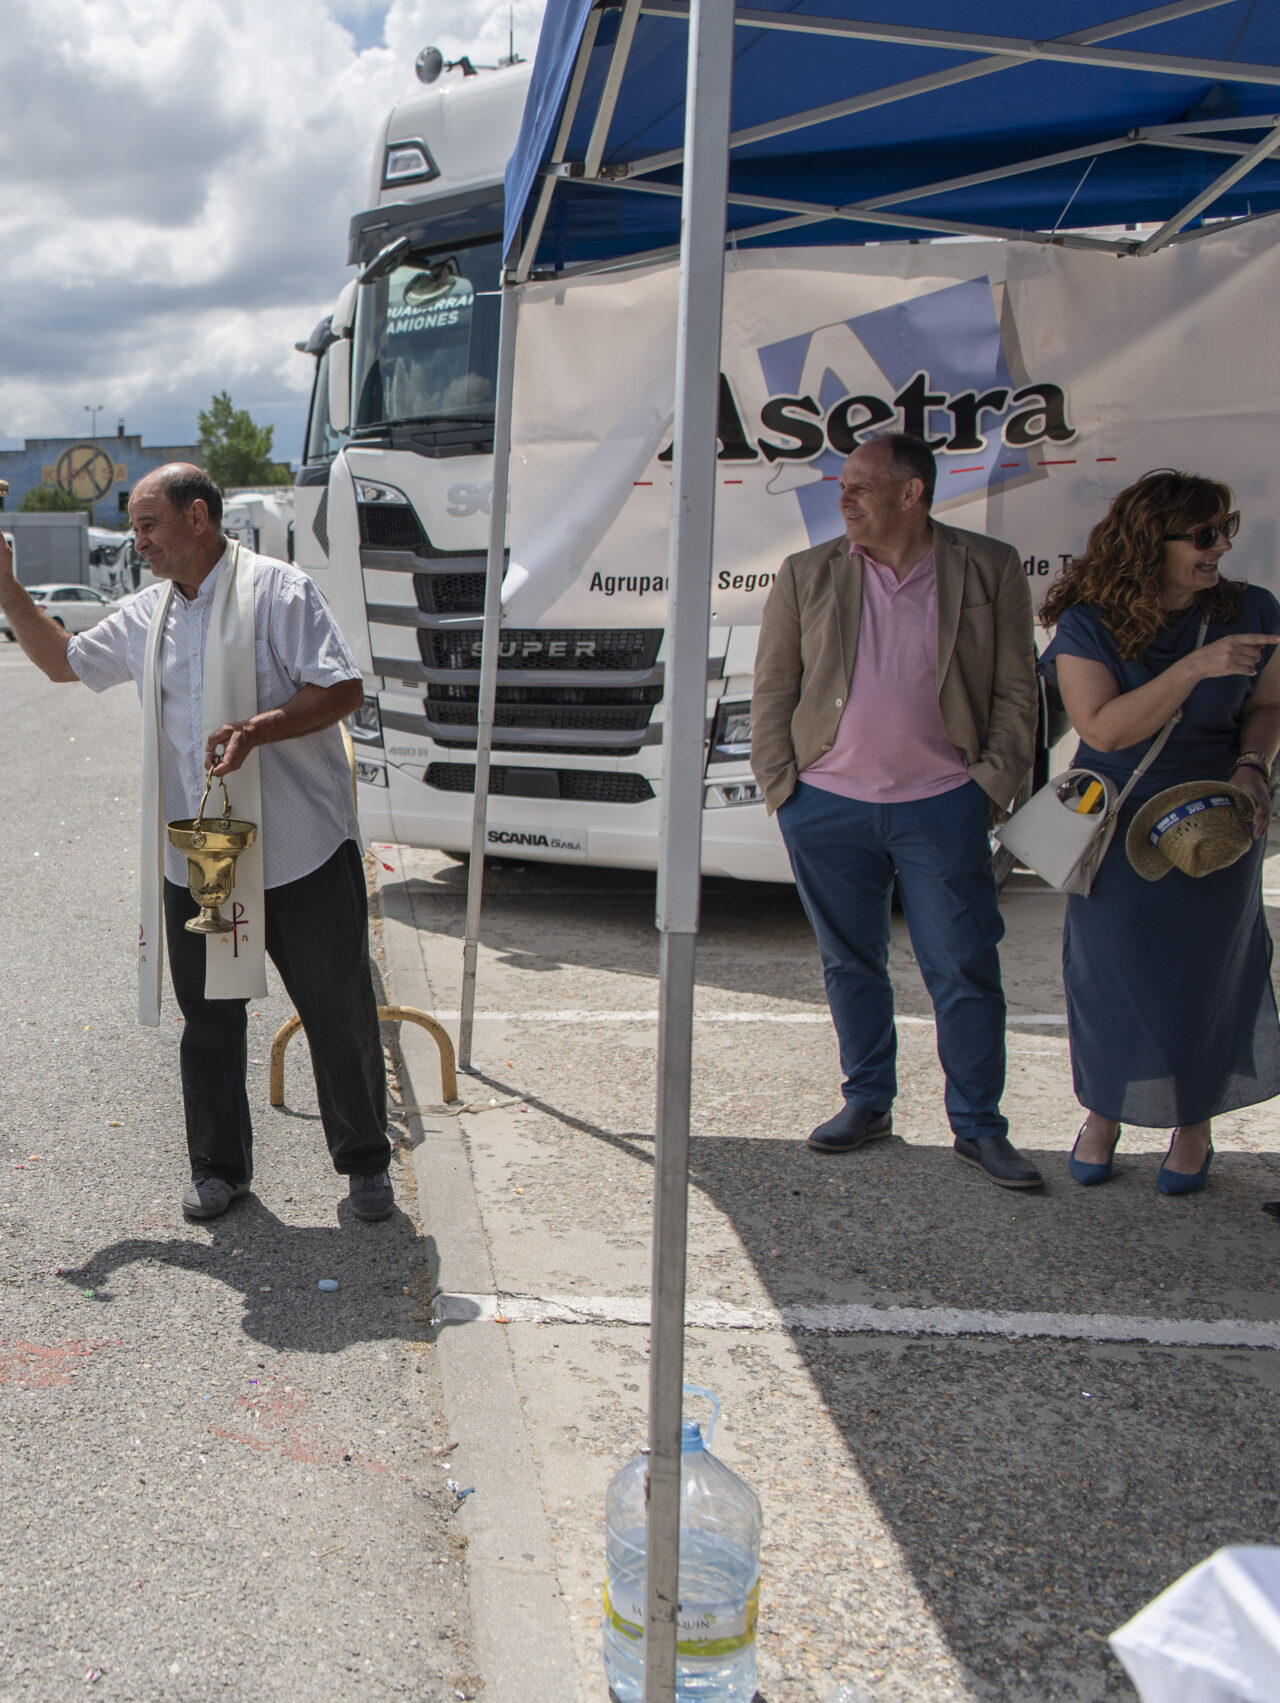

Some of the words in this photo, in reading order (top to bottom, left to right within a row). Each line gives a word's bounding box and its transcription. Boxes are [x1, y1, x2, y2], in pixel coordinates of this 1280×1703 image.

[386, 310, 459, 335] AMIONES
[658, 370, 1077, 463] Asetra
[1023, 555, 1049, 576] de
[470, 641, 596, 658] SUPER
[487, 830, 549, 848] SCANIA
